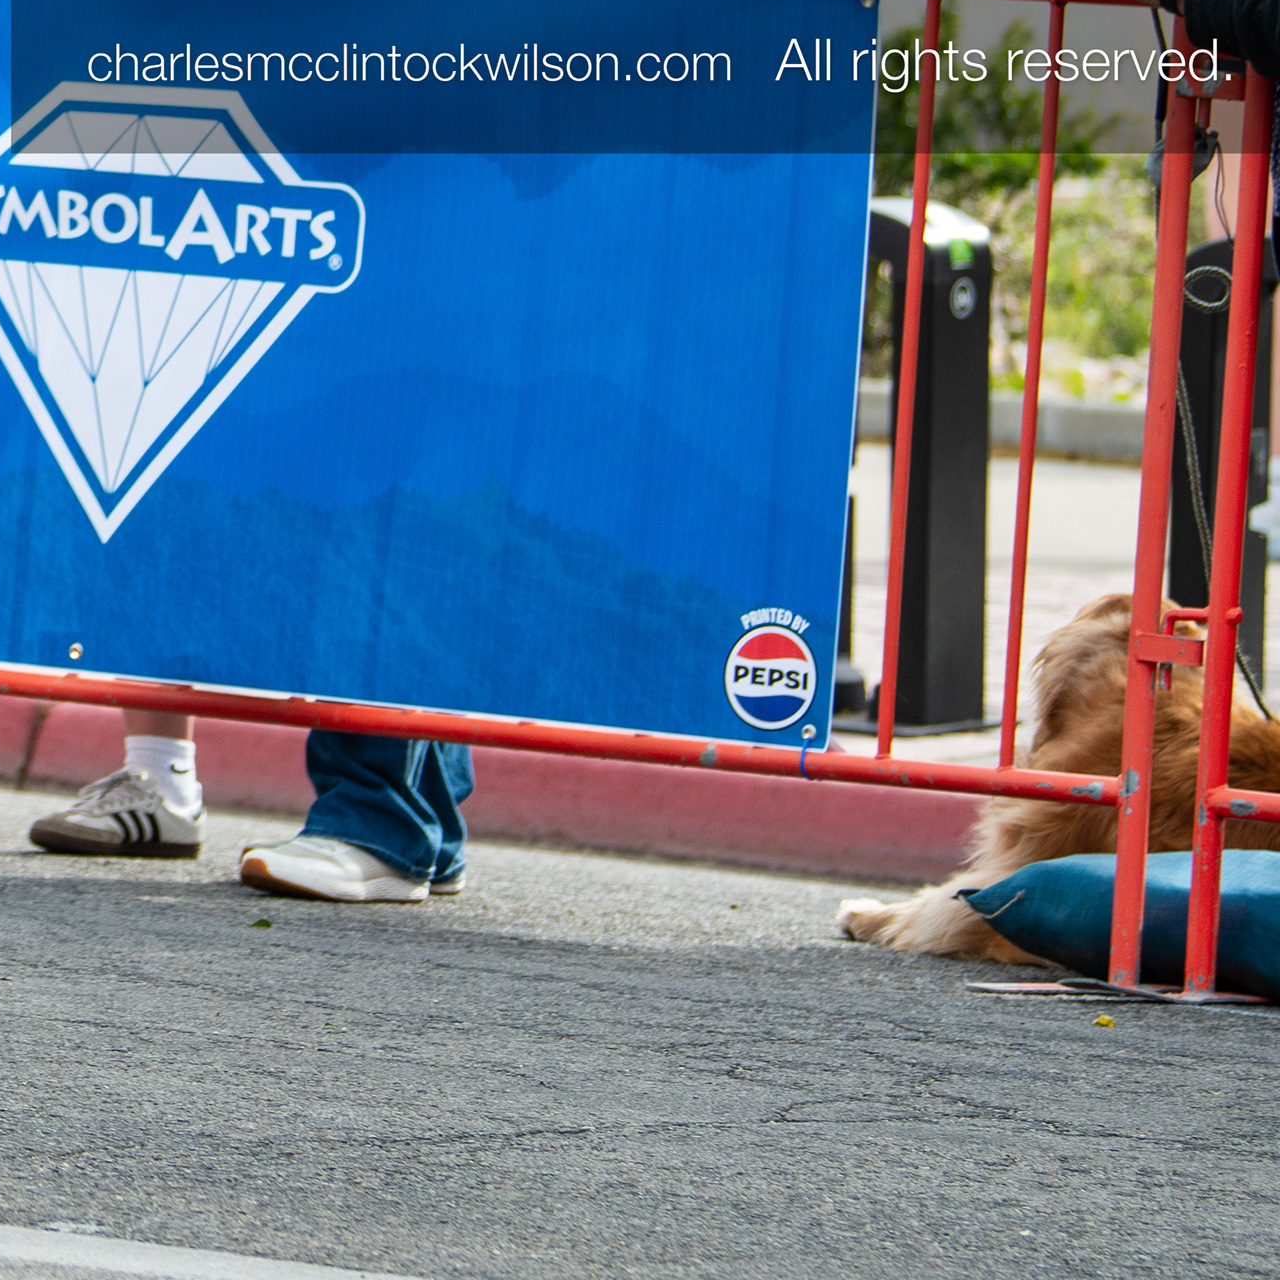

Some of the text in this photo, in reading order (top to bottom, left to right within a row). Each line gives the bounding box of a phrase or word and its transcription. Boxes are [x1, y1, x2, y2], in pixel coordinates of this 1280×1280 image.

[740, 607, 810, 634] PRINTED BY
[733, 664, 810, 690] PEPSI
